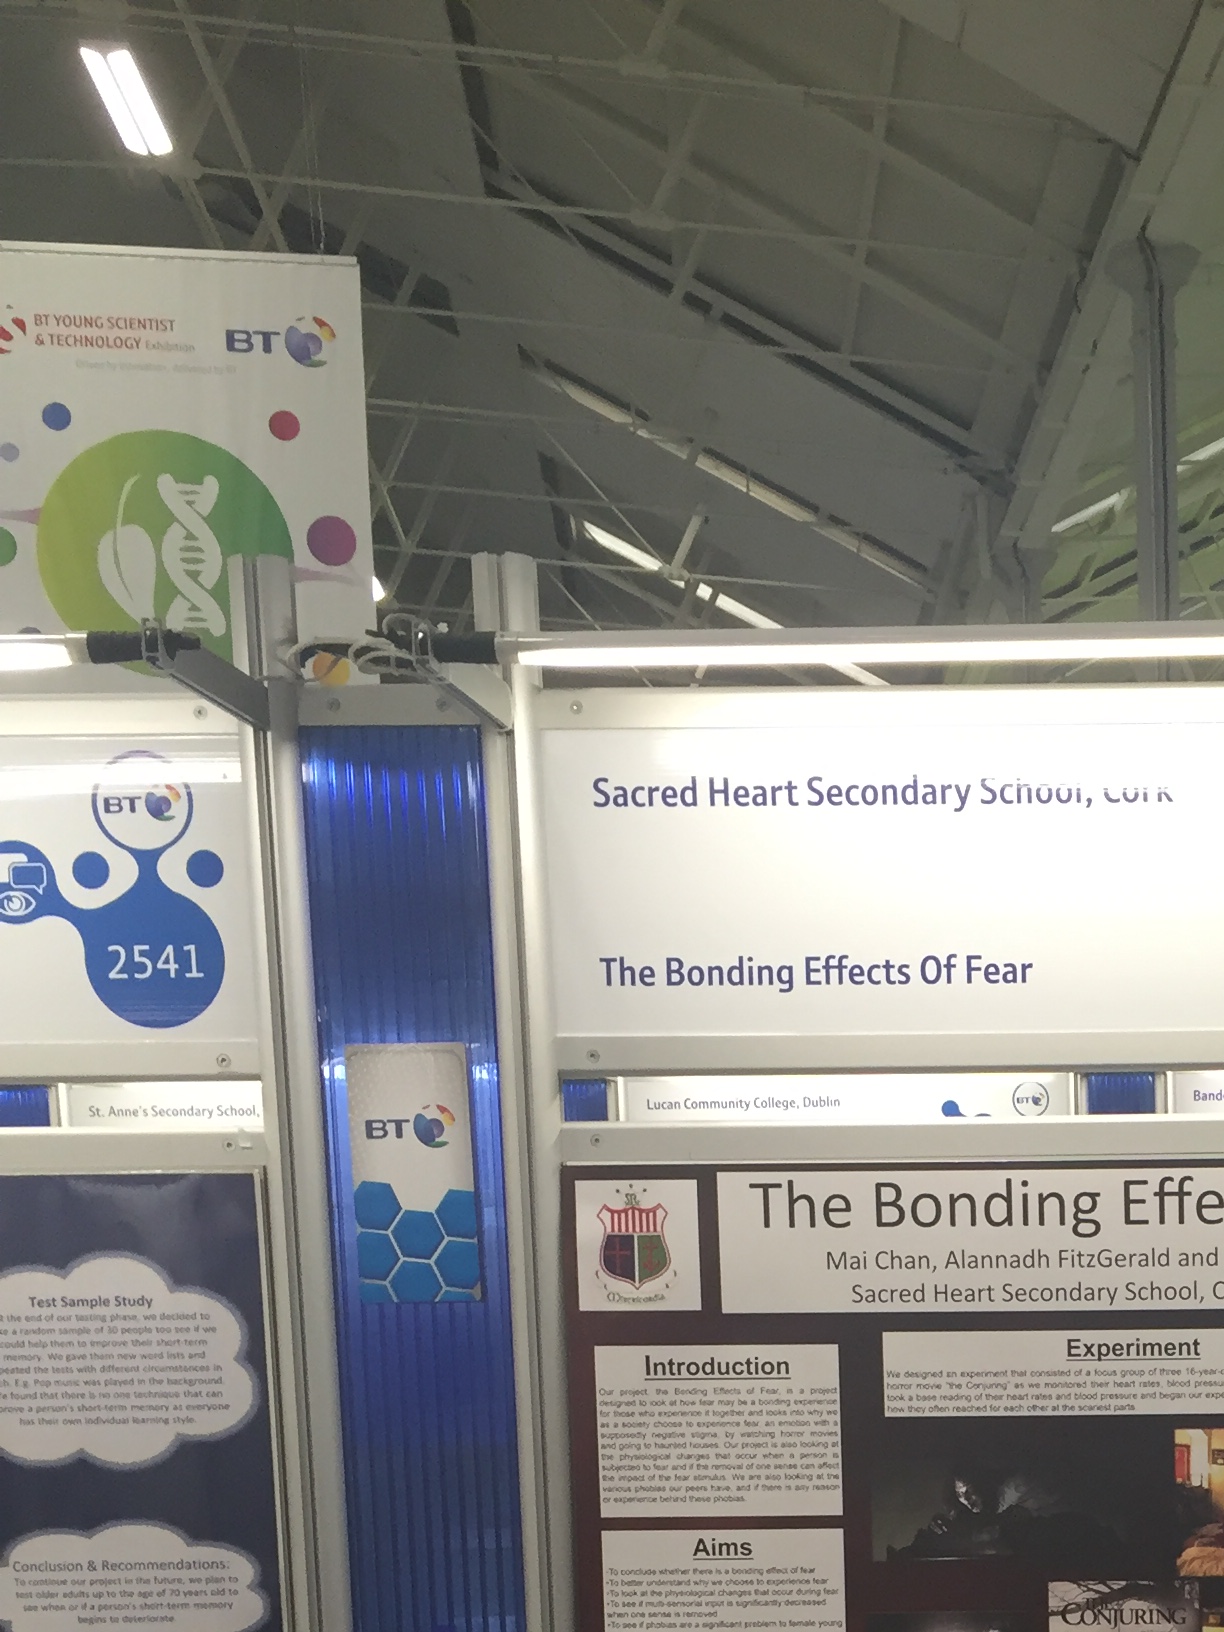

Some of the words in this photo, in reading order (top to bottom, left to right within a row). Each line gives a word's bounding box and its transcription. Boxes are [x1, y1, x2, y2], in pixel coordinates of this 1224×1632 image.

[33, 313, 50, 326] BT
[52, 313, 104, 329] YOUNG
[106, 316, 175, 332] SCIENTIST
[34, 333, 45, 346] &
[47, 333, 141, 349] TECHNOLOGY
[225, 329, 281, 354] BT
[592, 775, 698, 807] Sacred
[708, 776, 799, 807] Heart
[806, 774, 971, 812] Secondary
[980, 778, 1092, 808] School,
[104, 796, 142, 814] BT
[107, 944, 204, 979] 2541
[598, 955, 655, 987] The
[665, 955, 794, 993] Bonding
[804, 954, 911, 985] Effects
[920, 953, 957, 984] Of
[966, 954, 1033, 984] Fear
[88, 1105, 105, 1118] St.
[107, 1105, 148, 1117] Anne's
[150, 1104, 213, 1119] Secondary
[216, 1104, 260, 1117] School,
[646, 1098, 681, 1110] Lucan
[683, 1097, 750, 1111] Community
[753, 1096, 799, 1110] College,
[802, 1095, 840, 1107] Dublin
[365, 1120, 409, 1139] BT
[748, 1179, 851, 1228] The
[874, 1177, 1101, 1238] Bonding
[826, 1250, 867, 1270] Mai
[875, 1249, 937, 1273] Chan,
[944, 1248, 1049, 1269] Alannadh
[1058, 1247, 1169, 1268] FitzGerald
[1178, 1246, 1218, 1267] and
[28, 1296, 57, 1308] Test
[60, 1295, 110, 1309] Sample
[114, 1294, 153, 1309] Study
[851, 1282, 925, 1303] Sacred
[934, 1283, 995, 1302] Heart
[1002, 1281, 1118, 1306] Secondary
[1125, 1279, 1204, 1303] School,
[1066, 1337, 1201, 1360] Experiment
[644, 1354, 789, 1376] Introduction
[692, 1537, 752, 1556] Aims
[12, 1560, 83, 1572] Conclusion
[86, 1559, 97, 1572] &
[101, 1558, 229, 1571] Recommendations:
[1061, 1603, 1186, 1628] CONJURING
